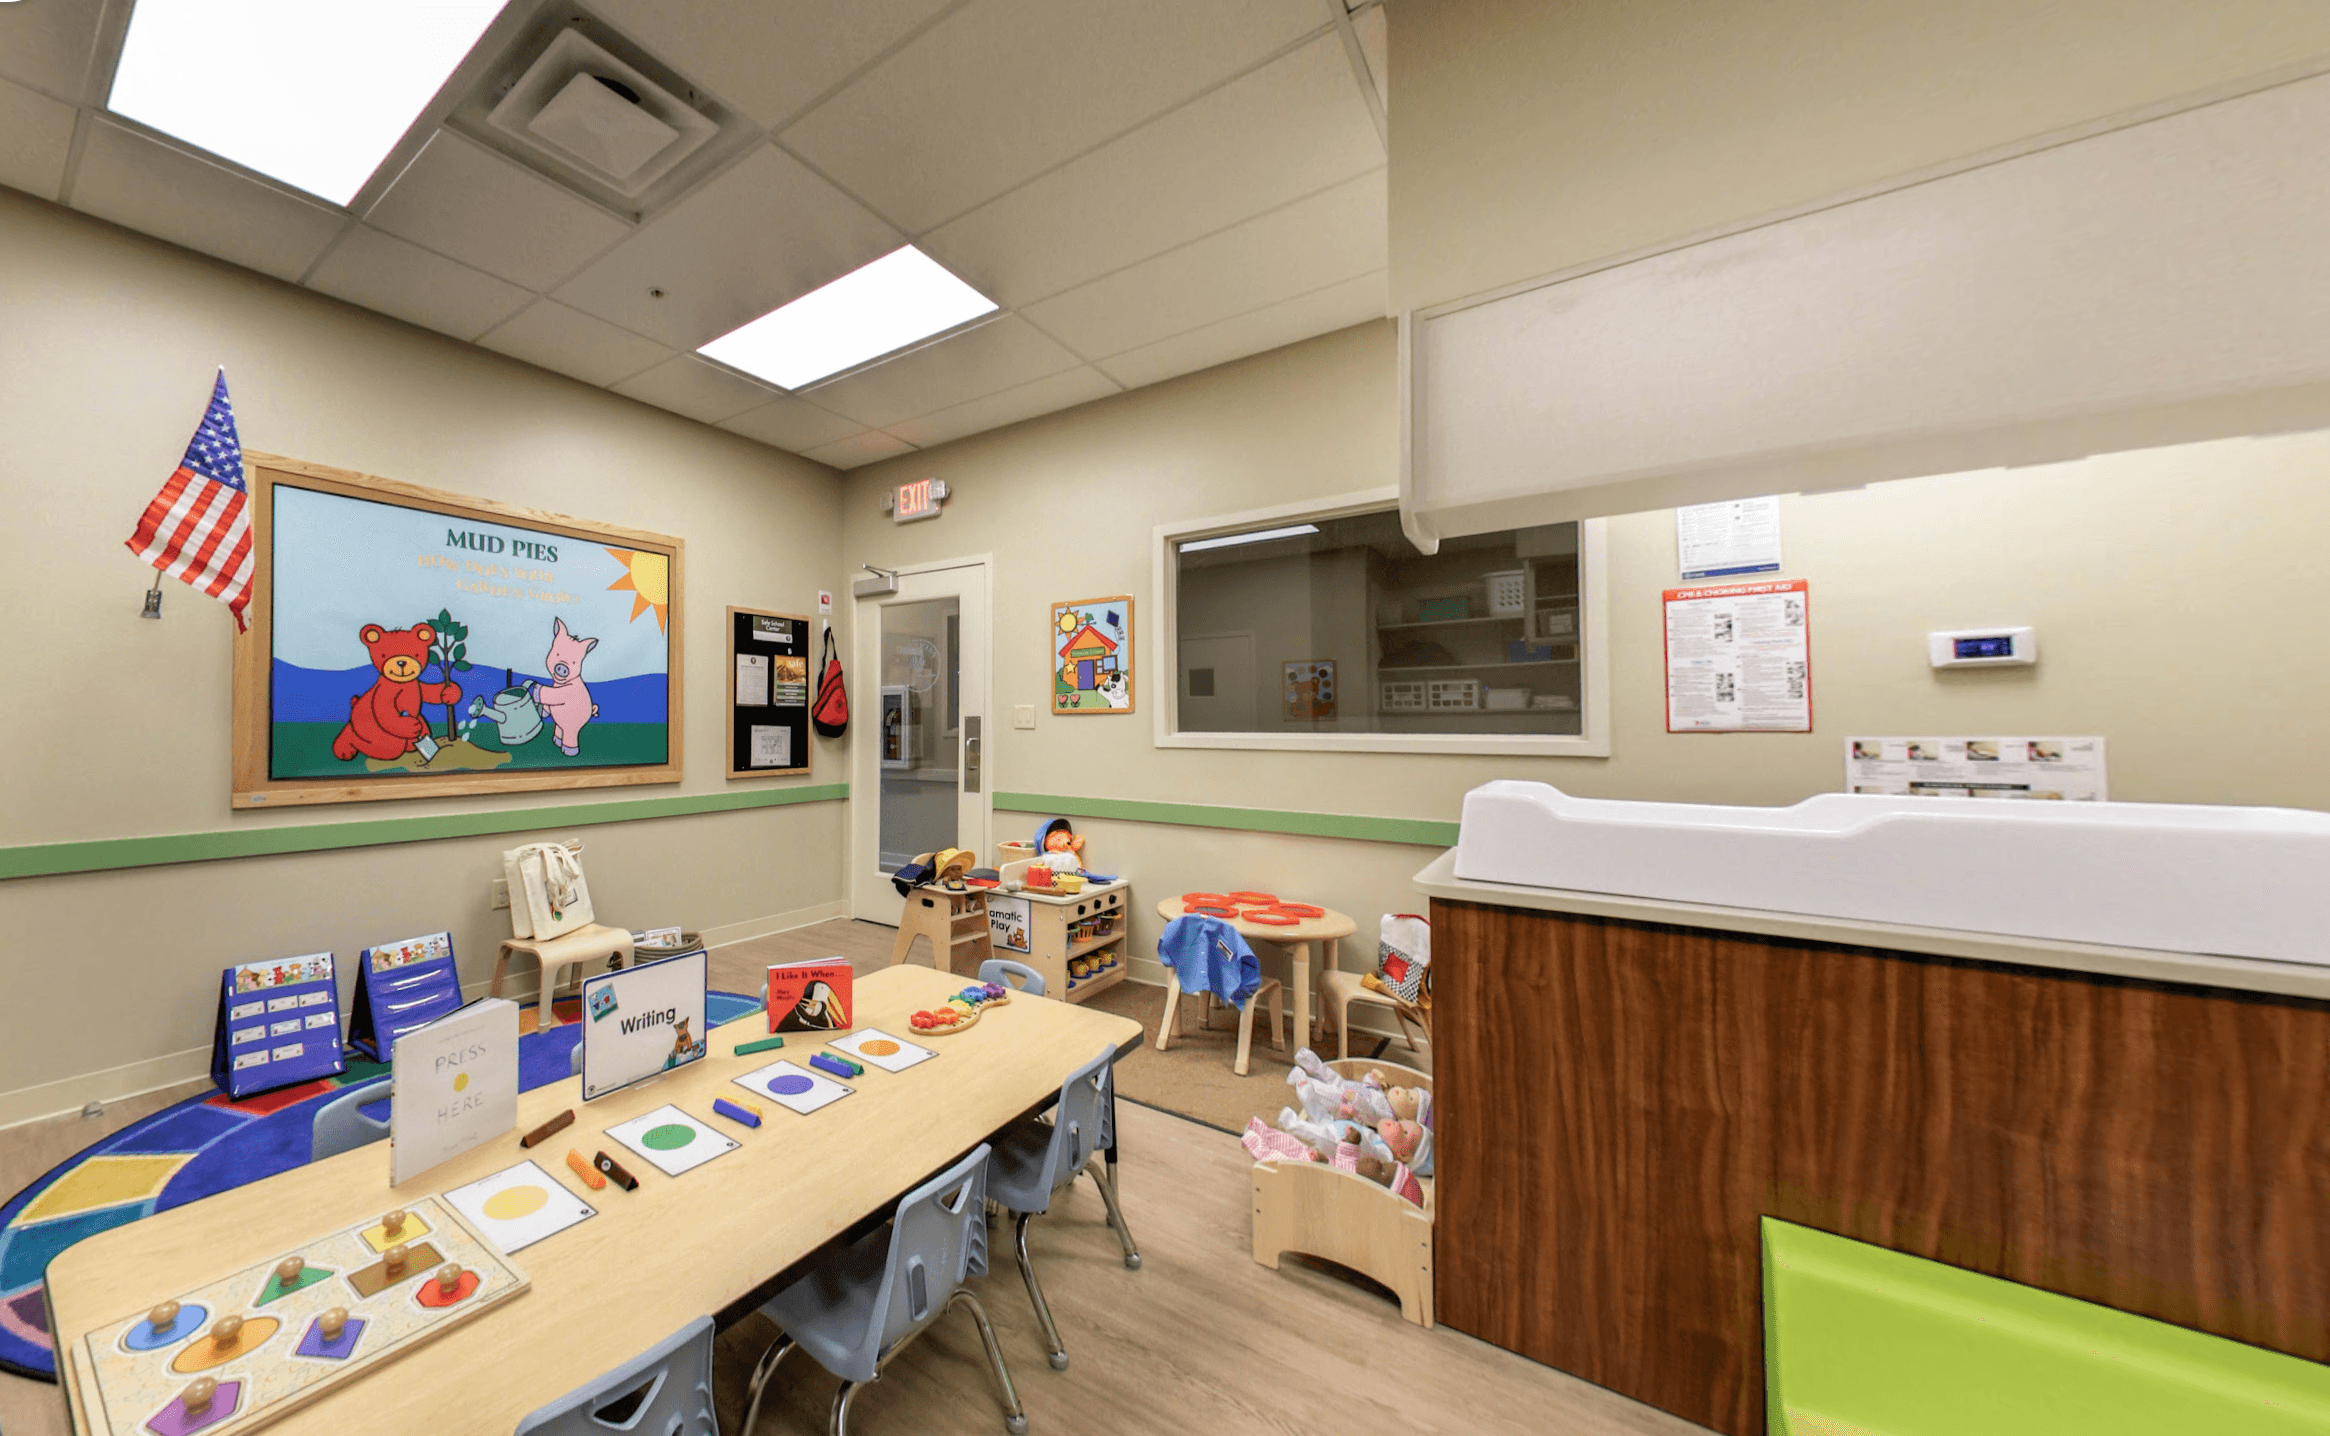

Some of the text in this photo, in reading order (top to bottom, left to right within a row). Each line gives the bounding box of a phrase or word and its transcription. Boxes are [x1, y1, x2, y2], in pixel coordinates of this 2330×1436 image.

[899, 479, 930, 515] EXIT
[446, 528, 559, 563] MUD PIES
[989, 910, 1023, 923] amatic
[991, 919, 1011, 933] Play
[781, 971, 799, 980] Like
[620, 1007, 677, 1036] Writing
[435, 1041, 487, 1074] PRESS
[437, 1091, 485, 1125] HERE
